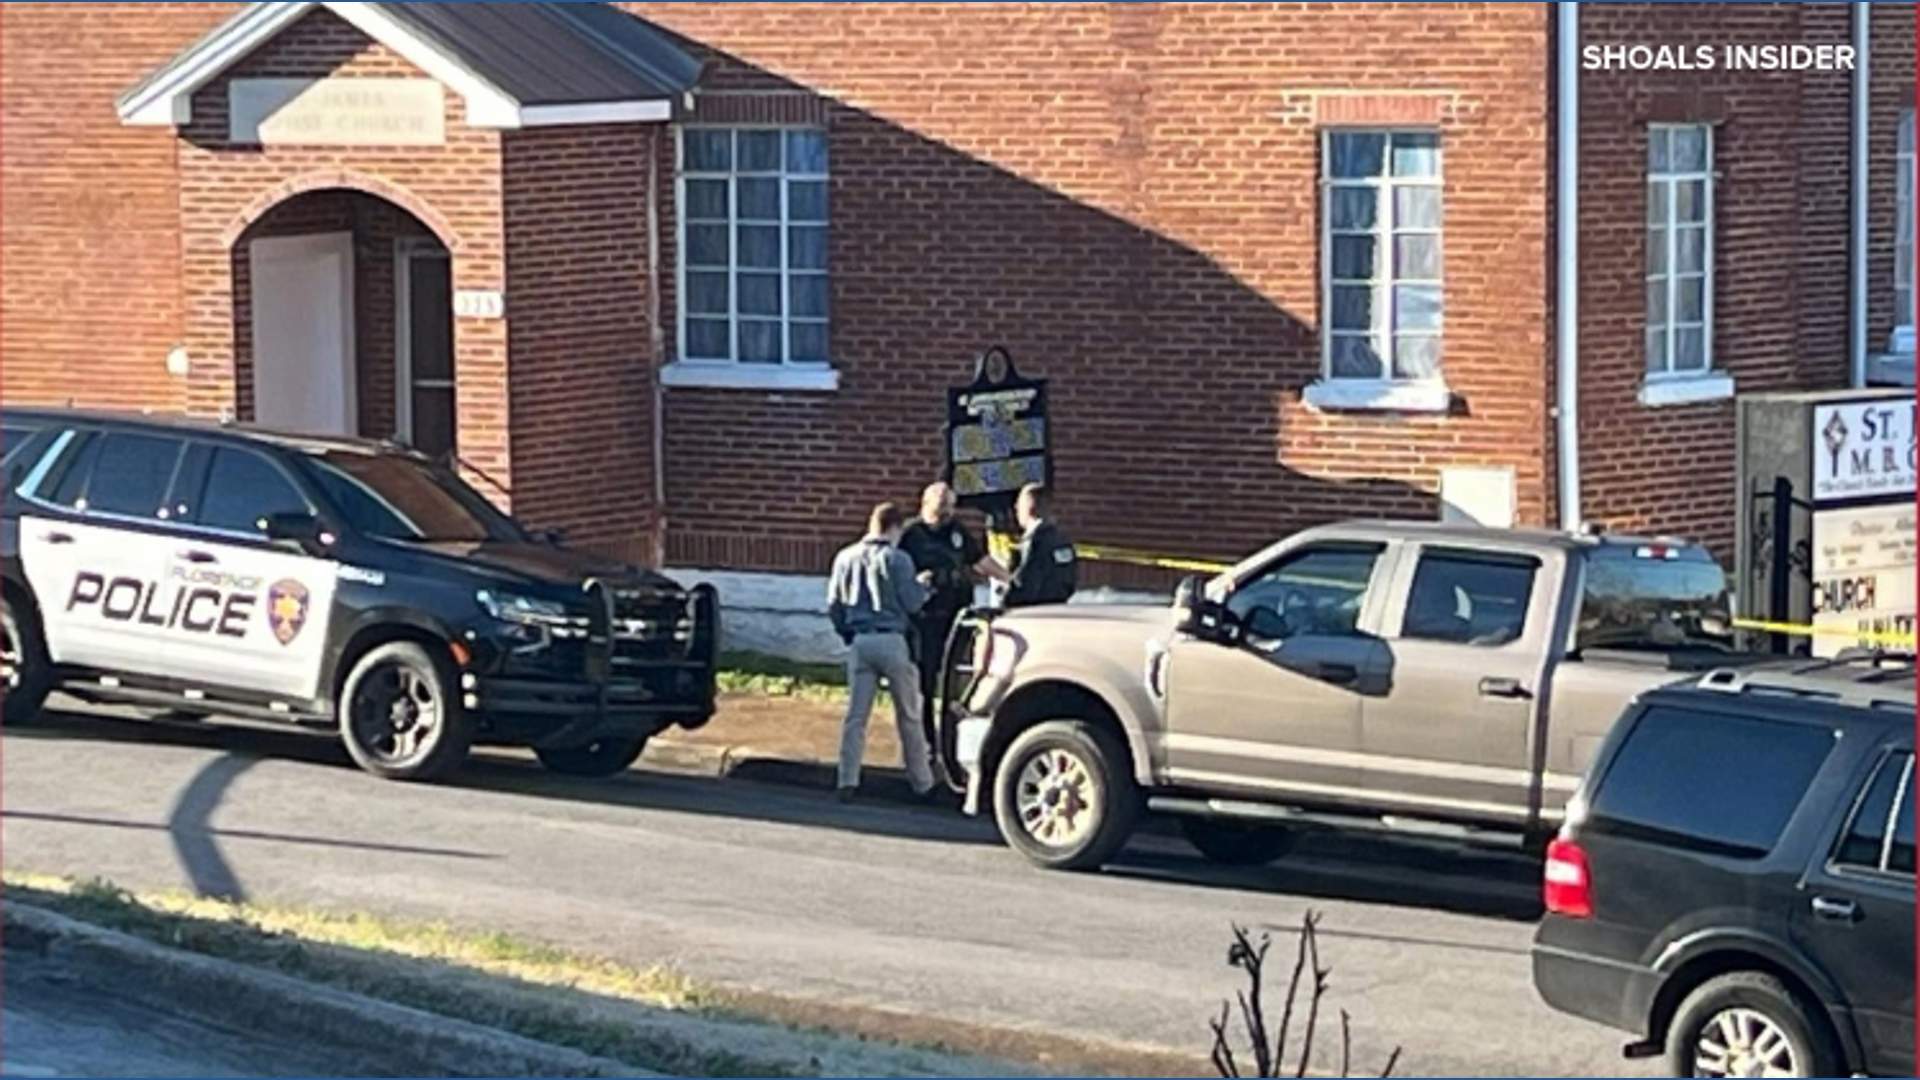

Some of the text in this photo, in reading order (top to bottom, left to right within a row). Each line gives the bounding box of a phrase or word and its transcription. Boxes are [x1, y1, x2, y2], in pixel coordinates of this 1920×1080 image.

[1860, 408, 1899, 442] ST.
[1851, 448, 1876, 475] M.
[65, 570, 258, 638] POLICE
[1812, 576, 1877, 613] CHURCH
